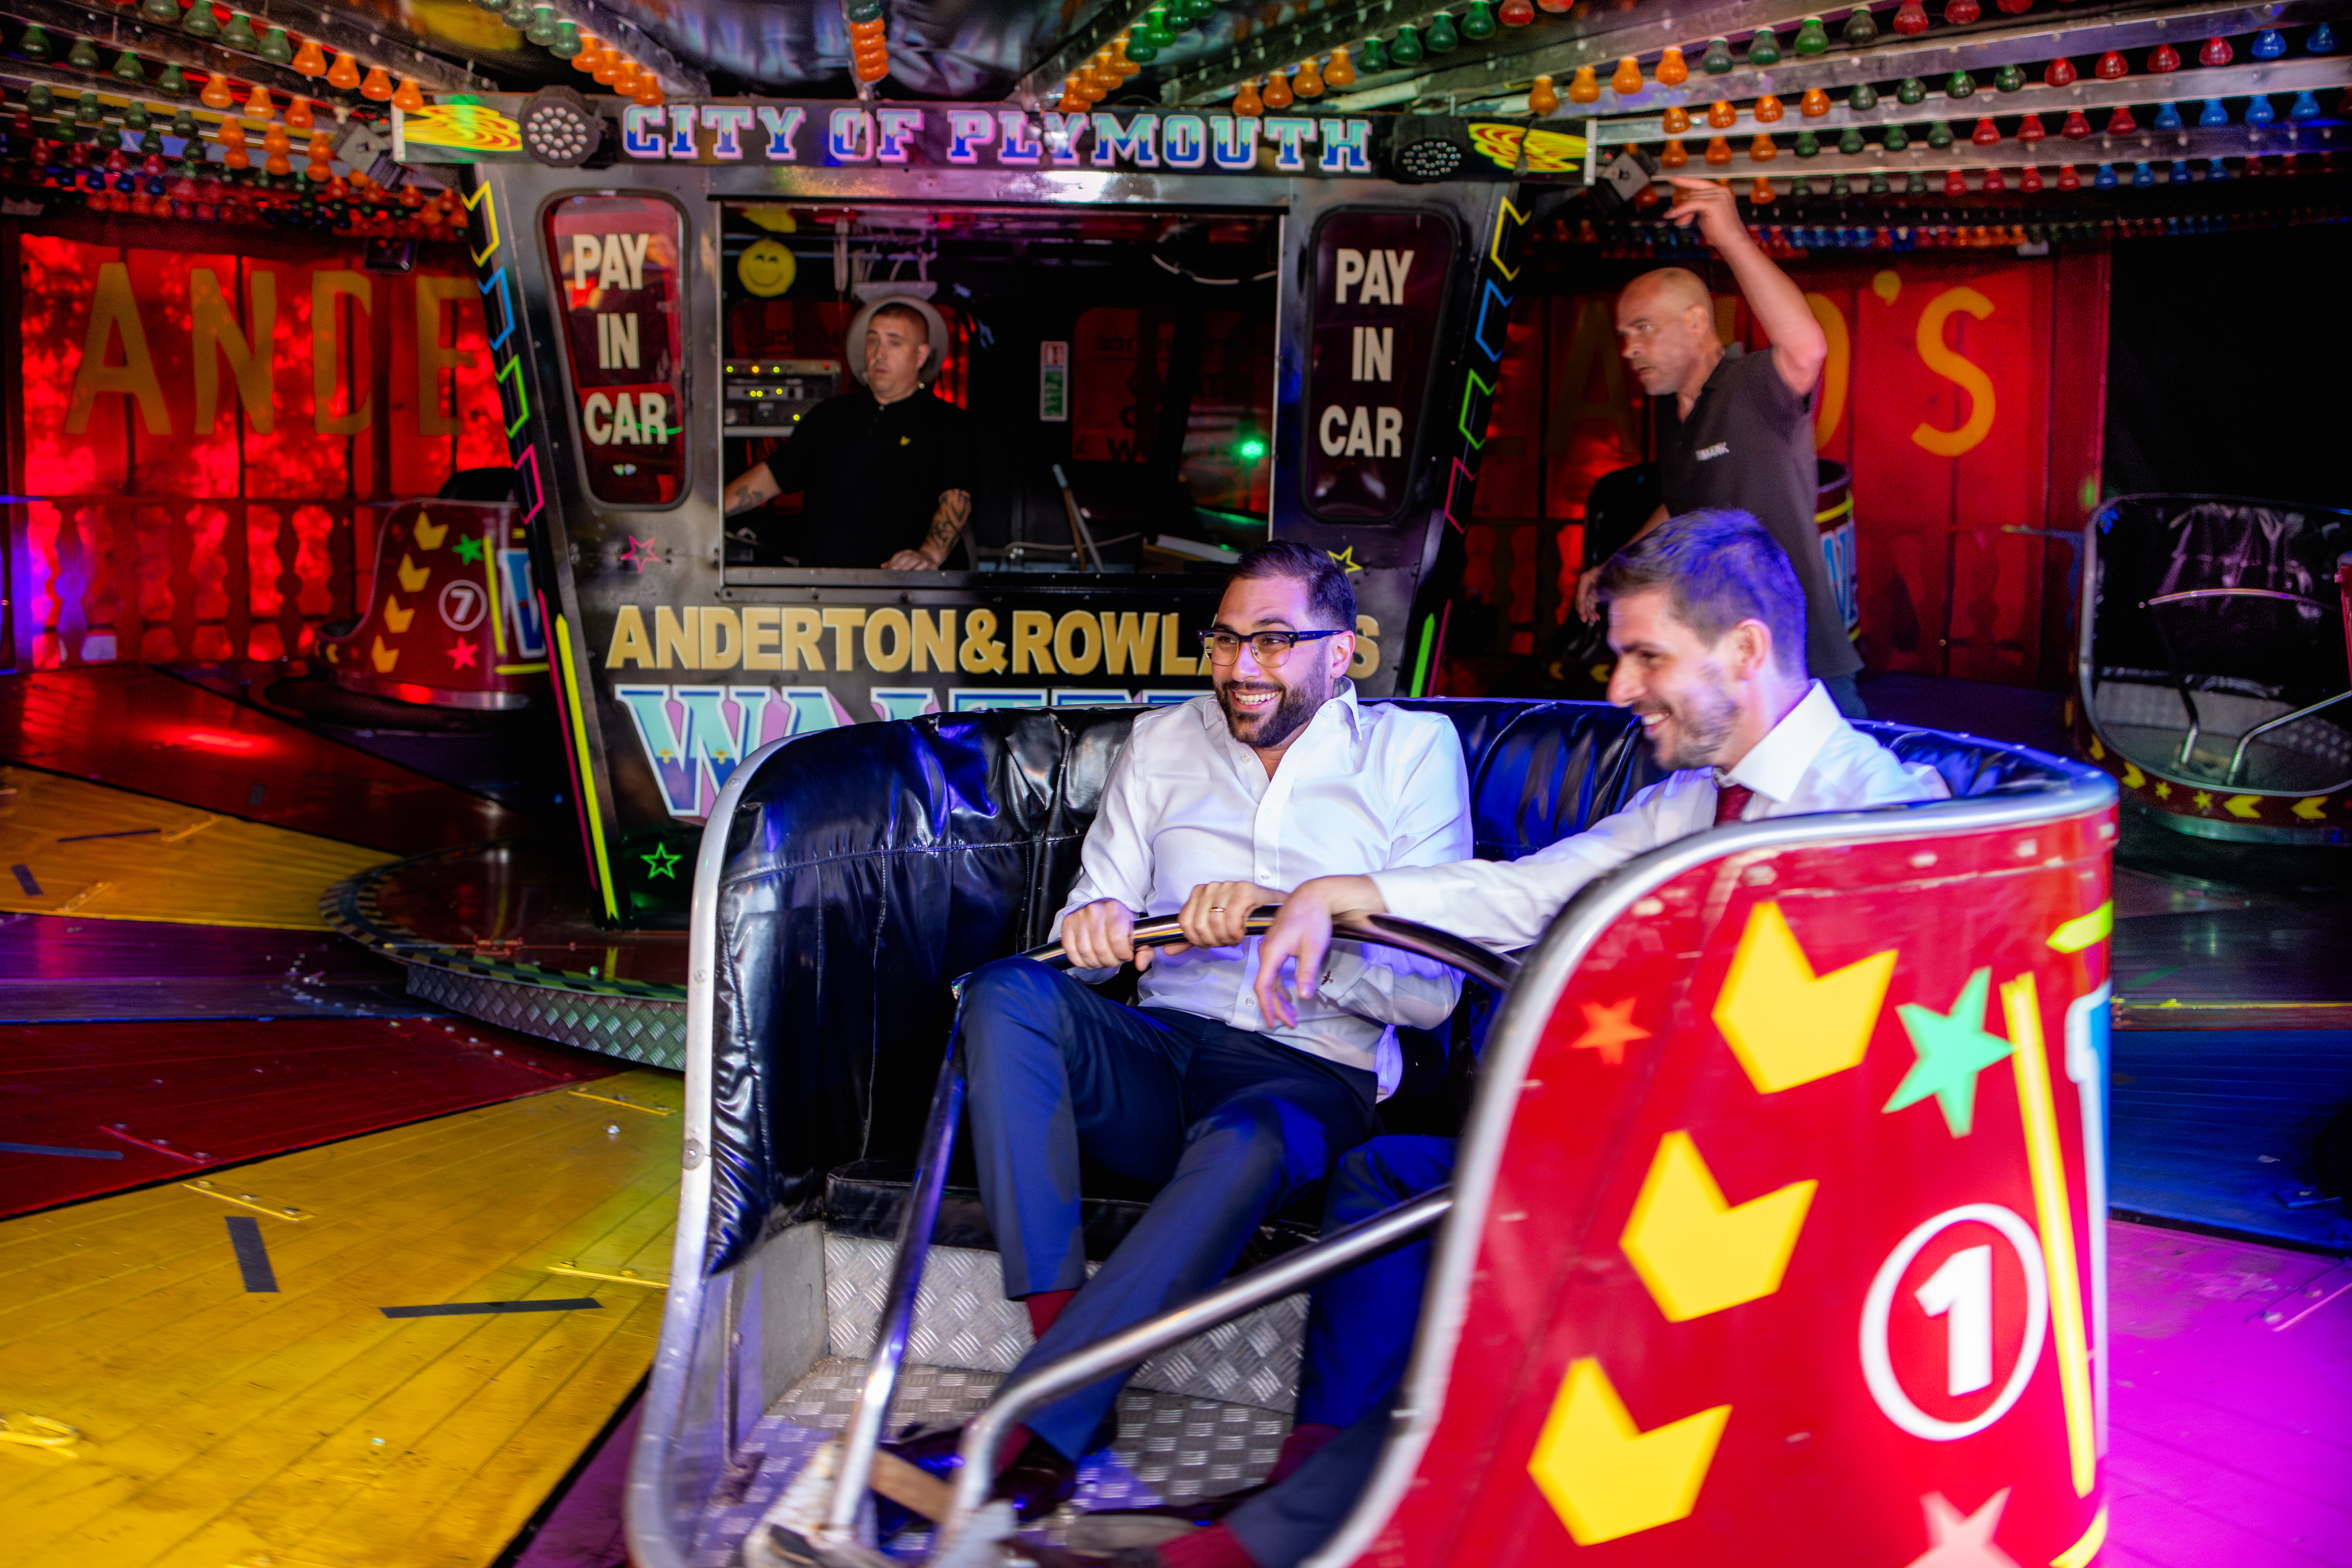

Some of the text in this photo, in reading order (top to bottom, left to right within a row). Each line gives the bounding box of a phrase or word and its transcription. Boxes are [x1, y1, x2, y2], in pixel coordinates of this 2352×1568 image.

[623, 103, 1372, 173] CITY OF PLYMOUTH
[573, 233, 650, 290] PAY
[1335, 249, 1413, 305] PAY
[597, 312, 640, 369] IN
[1352, 326, 1394, 382] IN
[583, 392, 668, 445] CAR
[1319, 404, 1403, 458] CAR
[450, 588, 475, 623] 7
[1913, 1243, 1994, 1397] 1
